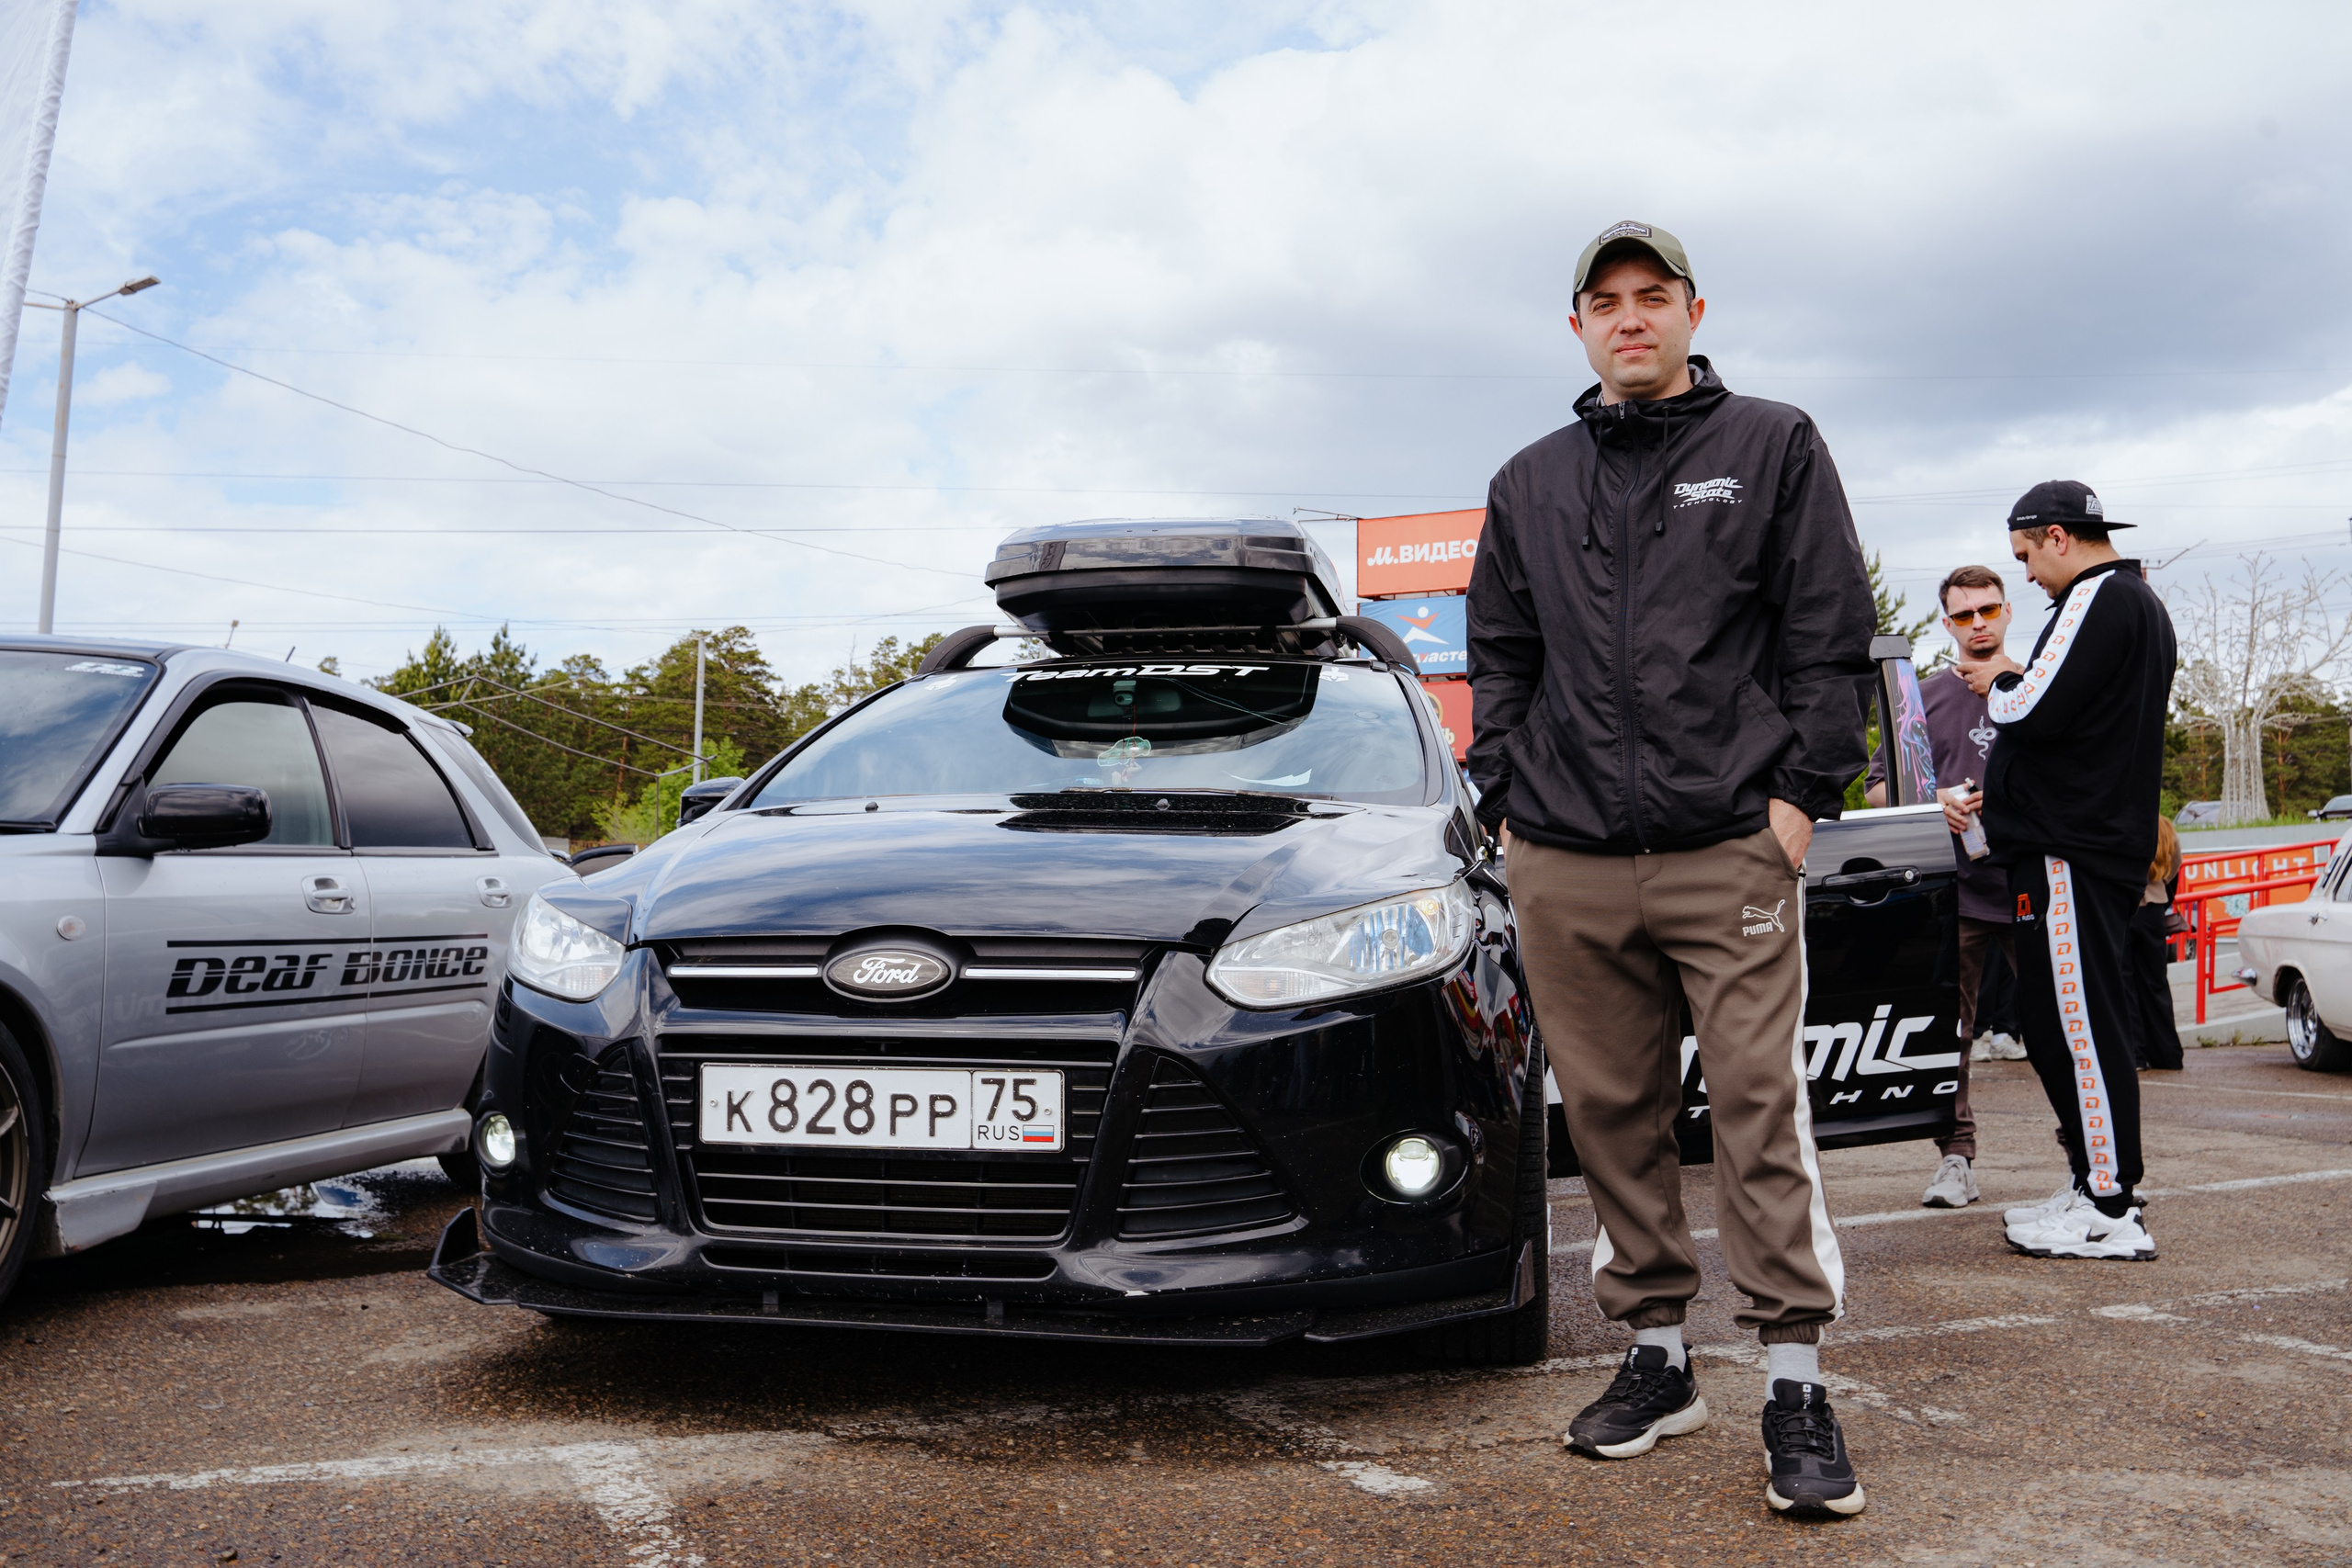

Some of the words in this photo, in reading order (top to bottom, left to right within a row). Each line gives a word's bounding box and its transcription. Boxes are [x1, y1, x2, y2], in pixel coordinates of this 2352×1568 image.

[1674, 477, 1744, 497] Dynamic
[1673, 497, 1743, 509] TECHNOLOGY
[1742, 921, 1773, 937] PUMA
[853, 956, 922, 984] Ford
[1804, 1004, 1961, 1082] mic
[980, 1077, 1038, 1122] 75
[978, 1124, 1020, 1141] RUS
